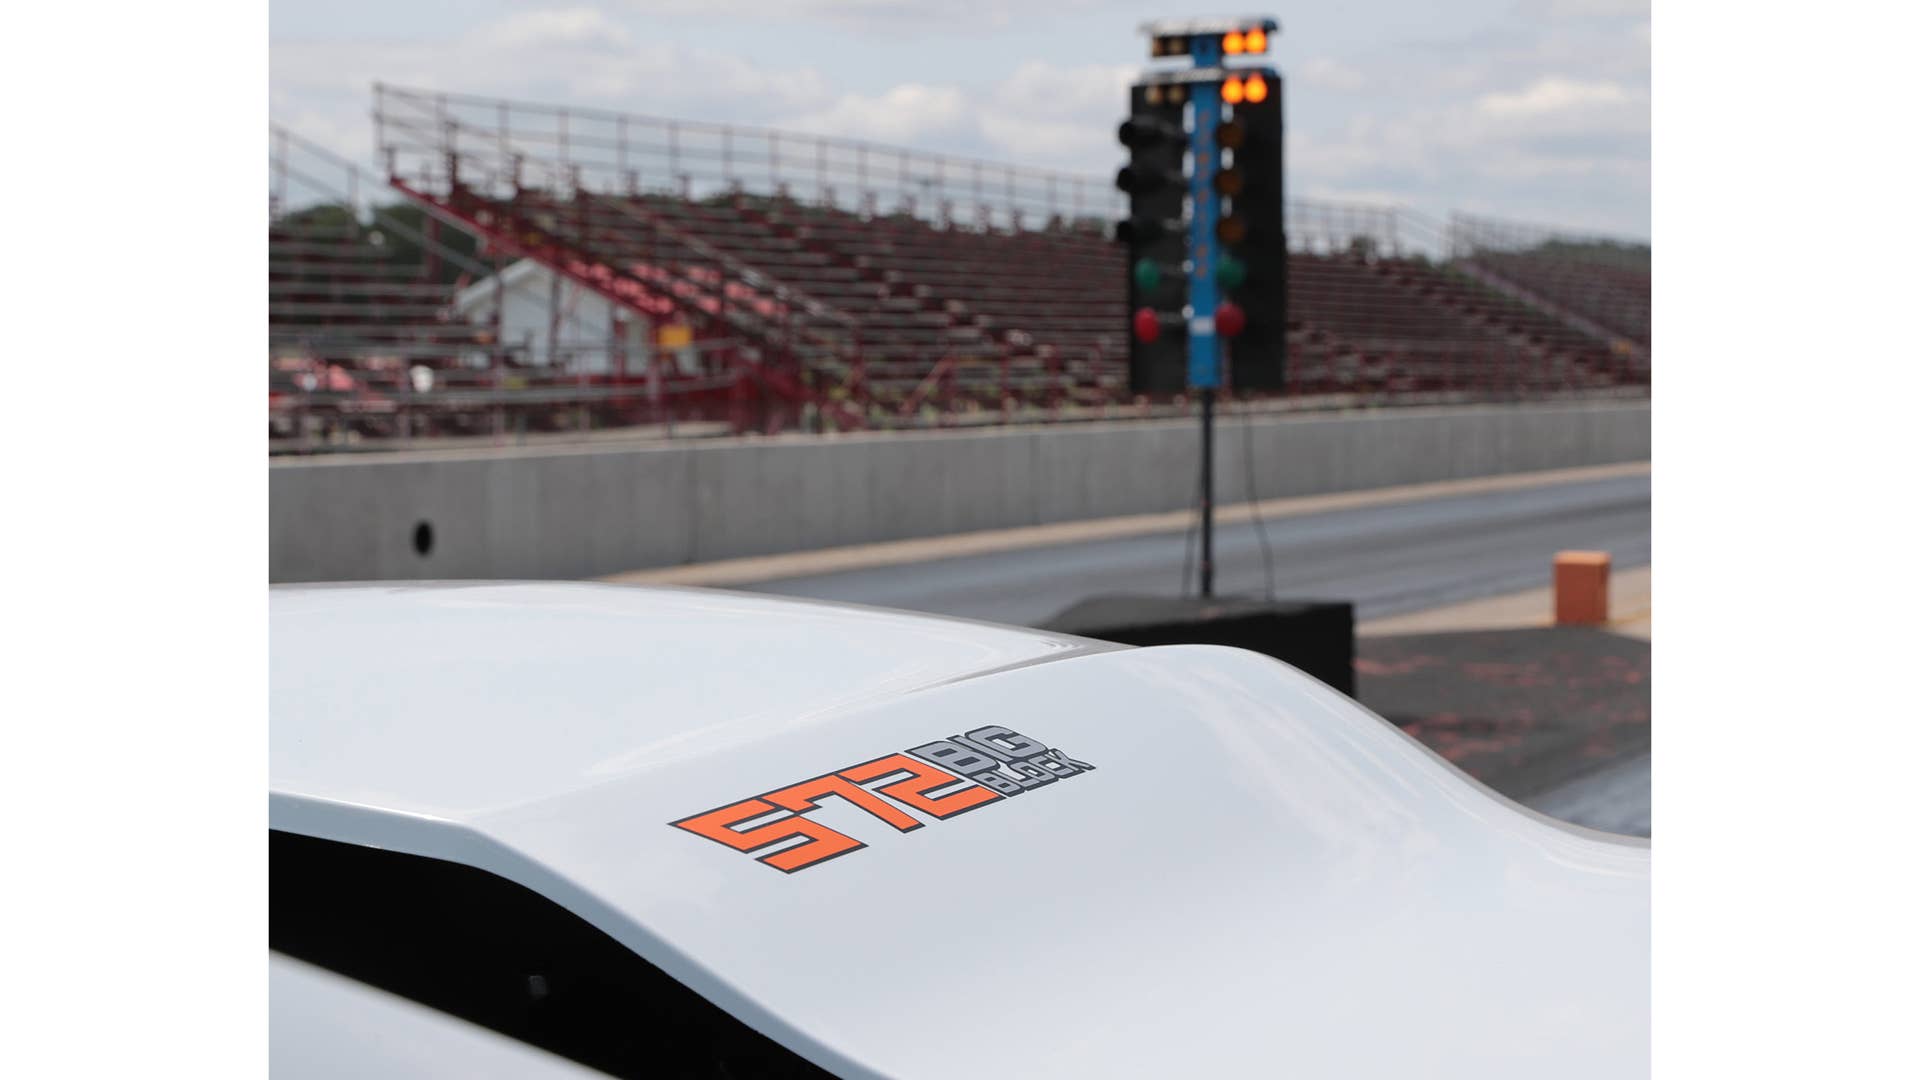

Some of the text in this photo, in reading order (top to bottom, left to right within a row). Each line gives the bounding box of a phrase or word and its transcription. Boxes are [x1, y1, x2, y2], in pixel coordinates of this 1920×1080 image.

[667, 725, 1049, 874] 572 BIG
[972, 748, 1096, 797] BLOCK
